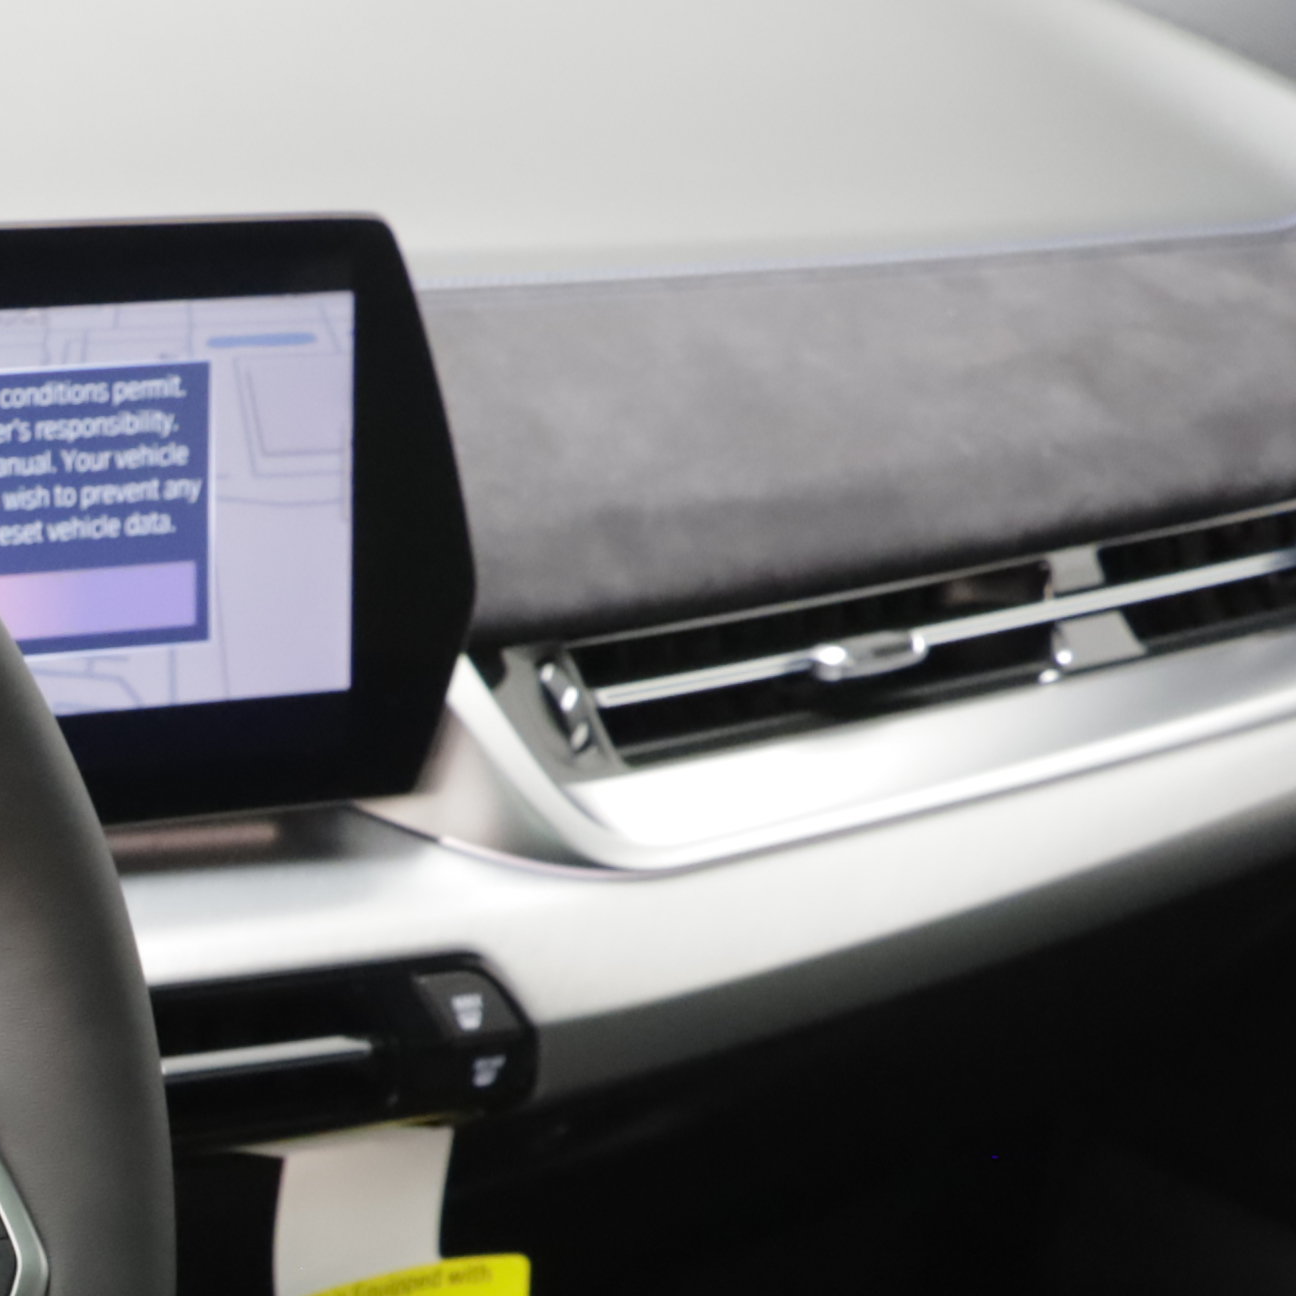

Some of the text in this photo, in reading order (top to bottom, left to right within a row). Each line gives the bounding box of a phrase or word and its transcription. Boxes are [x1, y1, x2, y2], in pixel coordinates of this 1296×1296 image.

[0, 379, 109, 409] conditions
[113, 375, 186, 406] permit.
[35, 411, 179, 443] responsibility.
[61, 449, 112, 474] Your
[115, 443, 190, 470] vehicle
[2, 485, 49, 513] wish
[54, 484, 77, 507] to
[80, 479, 159, 511] prevent
[163, 476, 202, 504] any
[47, 516, 122, 543] vehicle
[125, 512, 177, 538] data.
